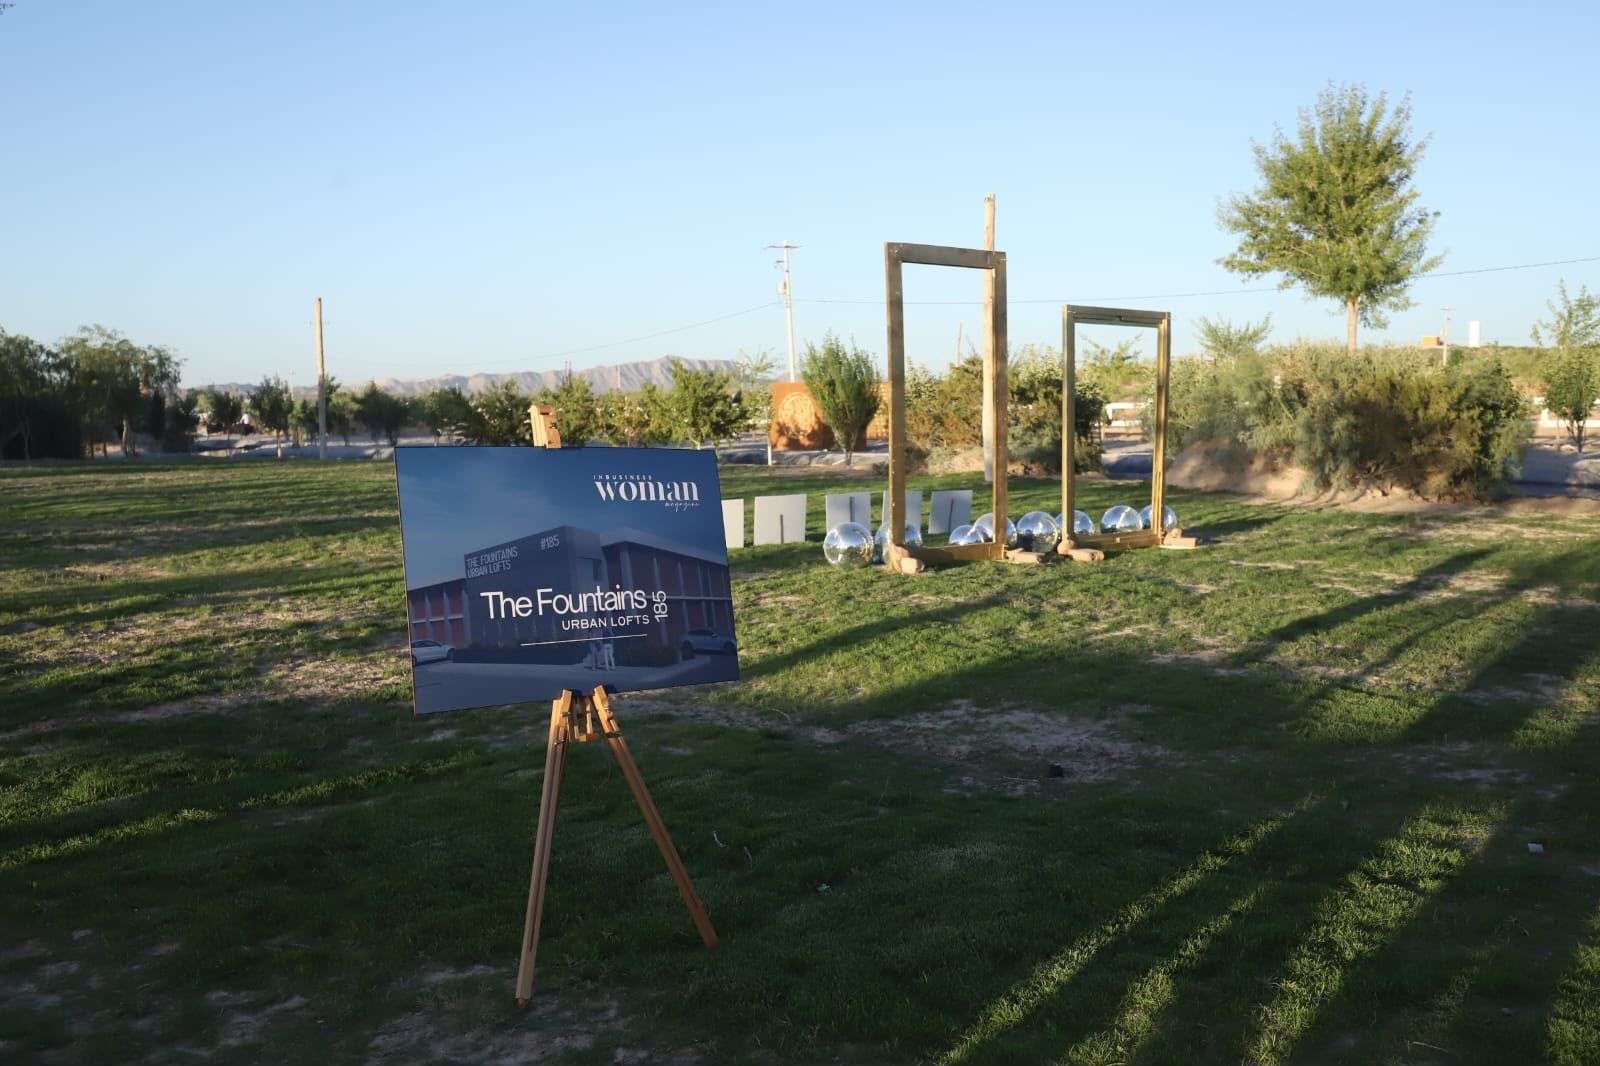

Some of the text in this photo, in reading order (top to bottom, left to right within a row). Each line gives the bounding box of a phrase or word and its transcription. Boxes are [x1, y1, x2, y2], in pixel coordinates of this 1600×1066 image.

[594, 481, 699, 502] woman
[540, 534, 560, 550] #185
[466, 546, 519, 568] THE FOUNTAINS
[467, 559, 511, 579] URBAN LOFTS
[480, 584, 648, 619] The Fountains
[653, 590, 669, 623] 185
[561, 614, 650, 631] URBAN LOFTS
